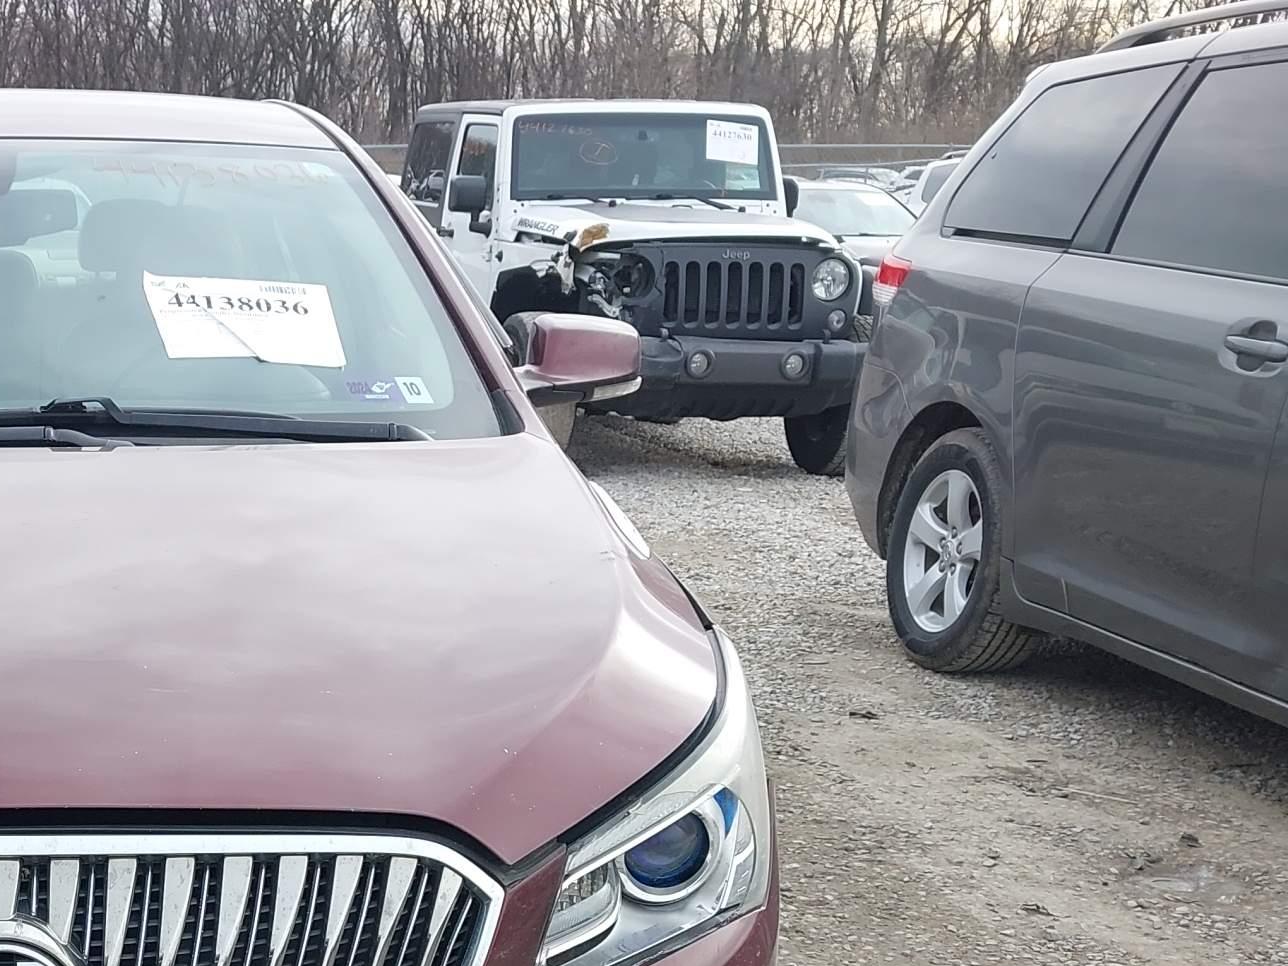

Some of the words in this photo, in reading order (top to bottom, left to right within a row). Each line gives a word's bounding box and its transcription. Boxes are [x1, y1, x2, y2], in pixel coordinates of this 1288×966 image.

[517, 217, 560, 235] WRANGLER
[722, 248, 751, 261] Jeep
[167, 292, 310, 317] 44138036
[403, 382, 421, 396] 10
